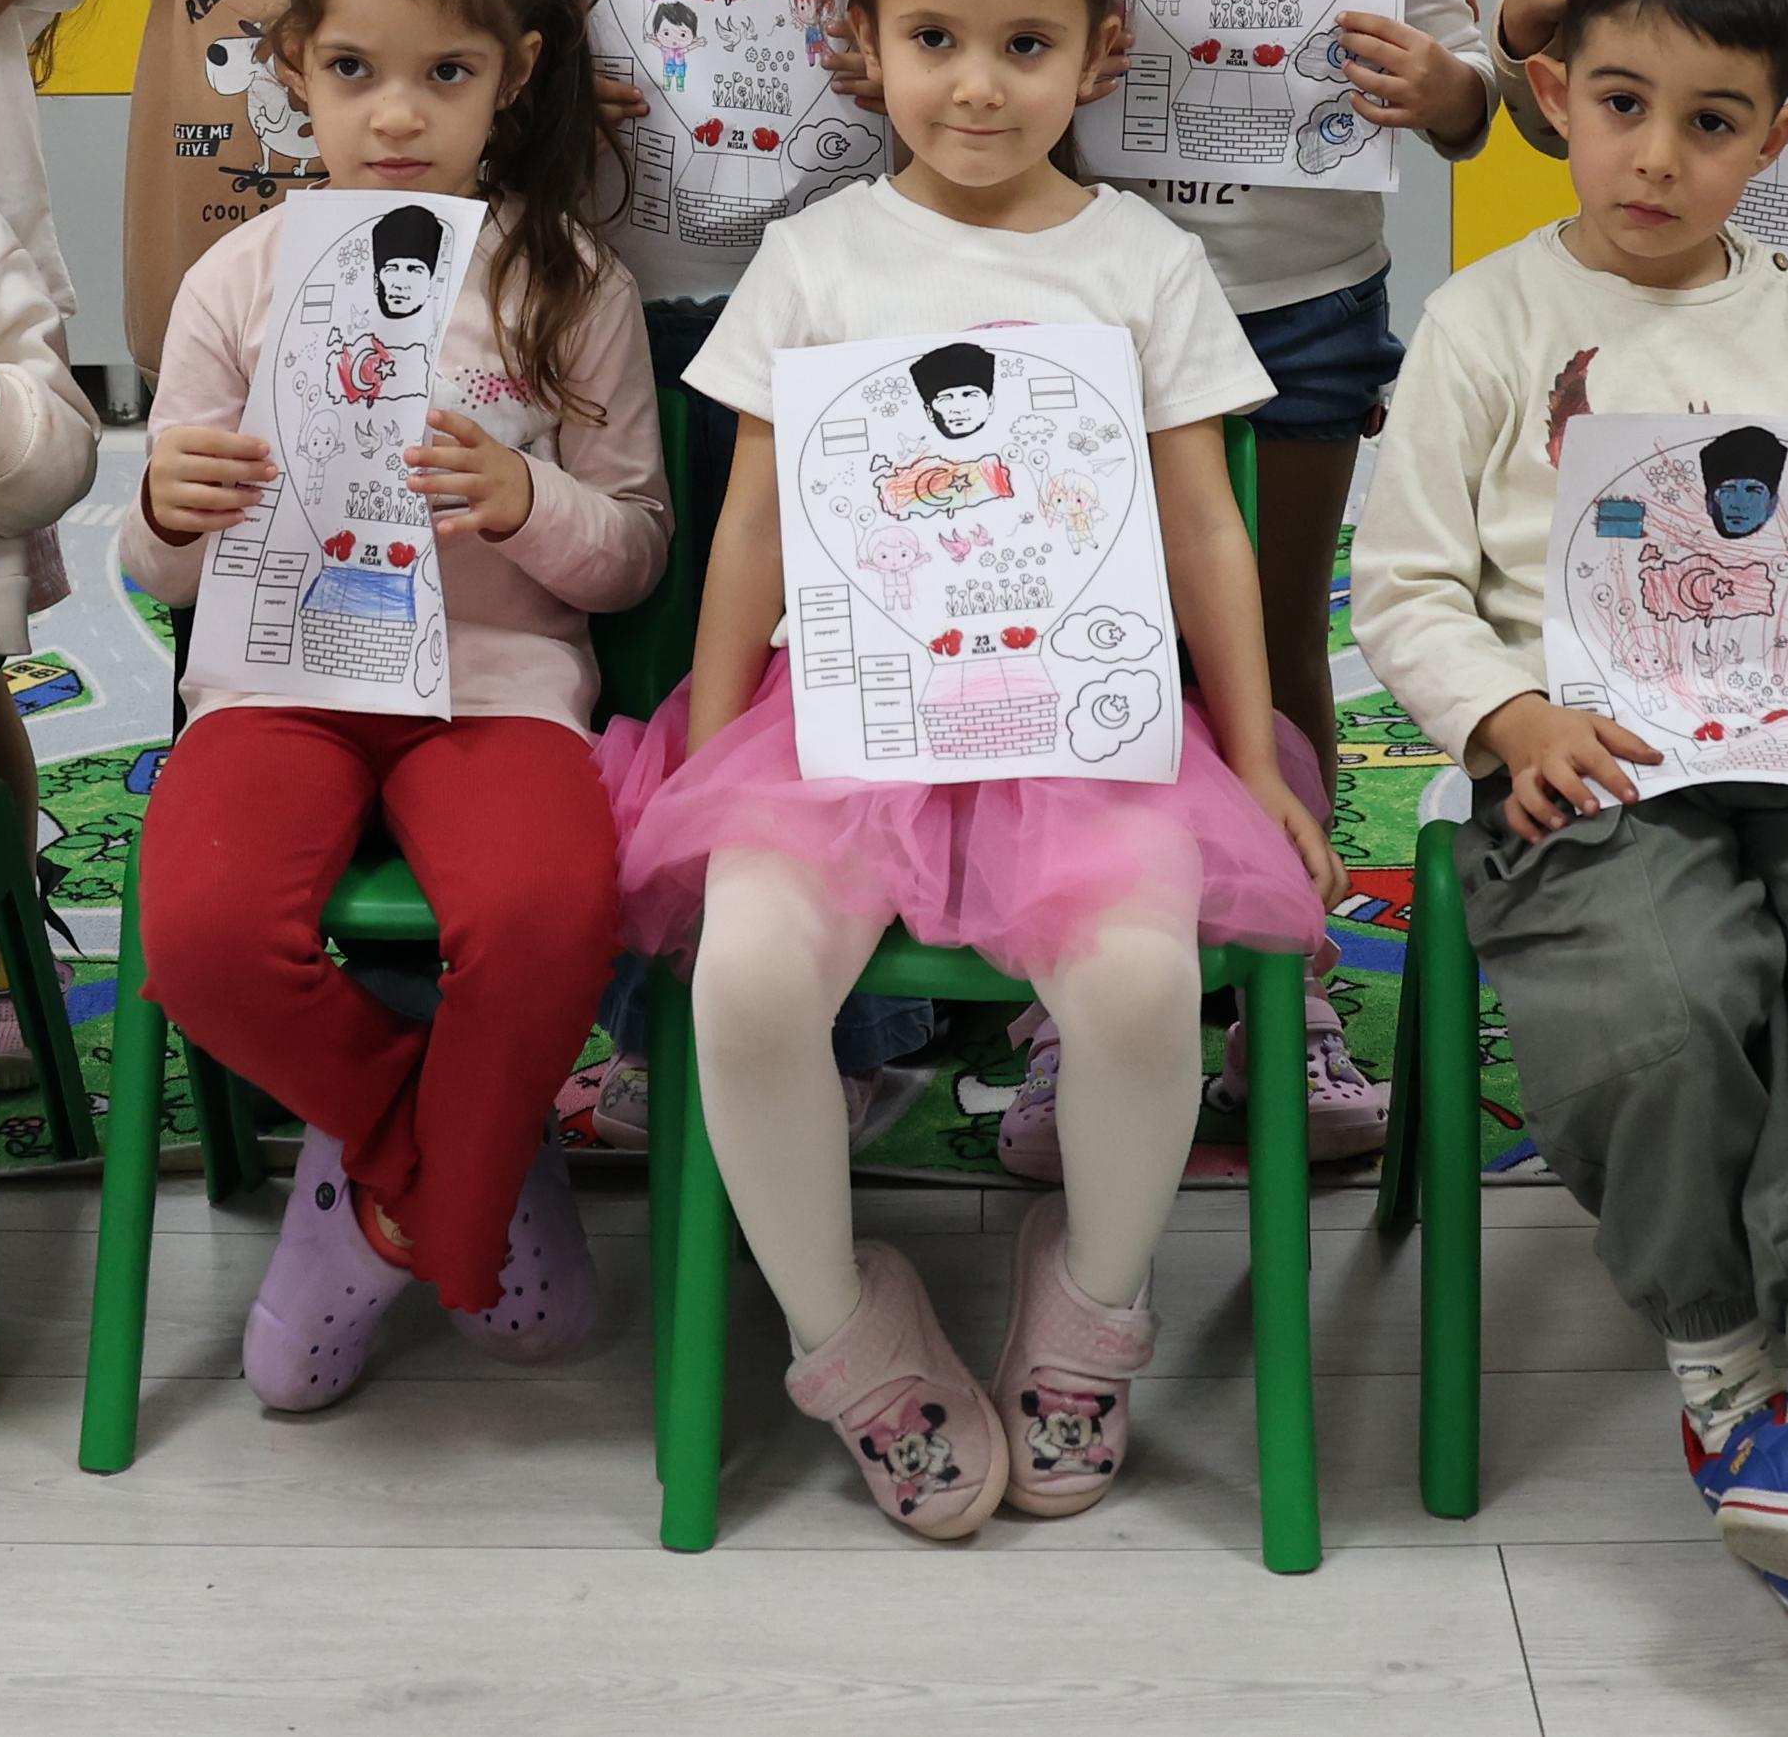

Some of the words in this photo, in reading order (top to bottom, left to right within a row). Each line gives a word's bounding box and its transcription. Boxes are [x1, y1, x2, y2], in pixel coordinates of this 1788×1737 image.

[1230, 49, 1243, 60] 23
[175, 125, 204, 139] GIVE
[210, 125, 229, 139] ME
[732, 130, 744, 141] 23
[179, 143, 210, 156] FIVE
[203, 204, 248, 222] COOL
[365, 544, 378, 556] 23
[975, 635, 990, 646] 23
